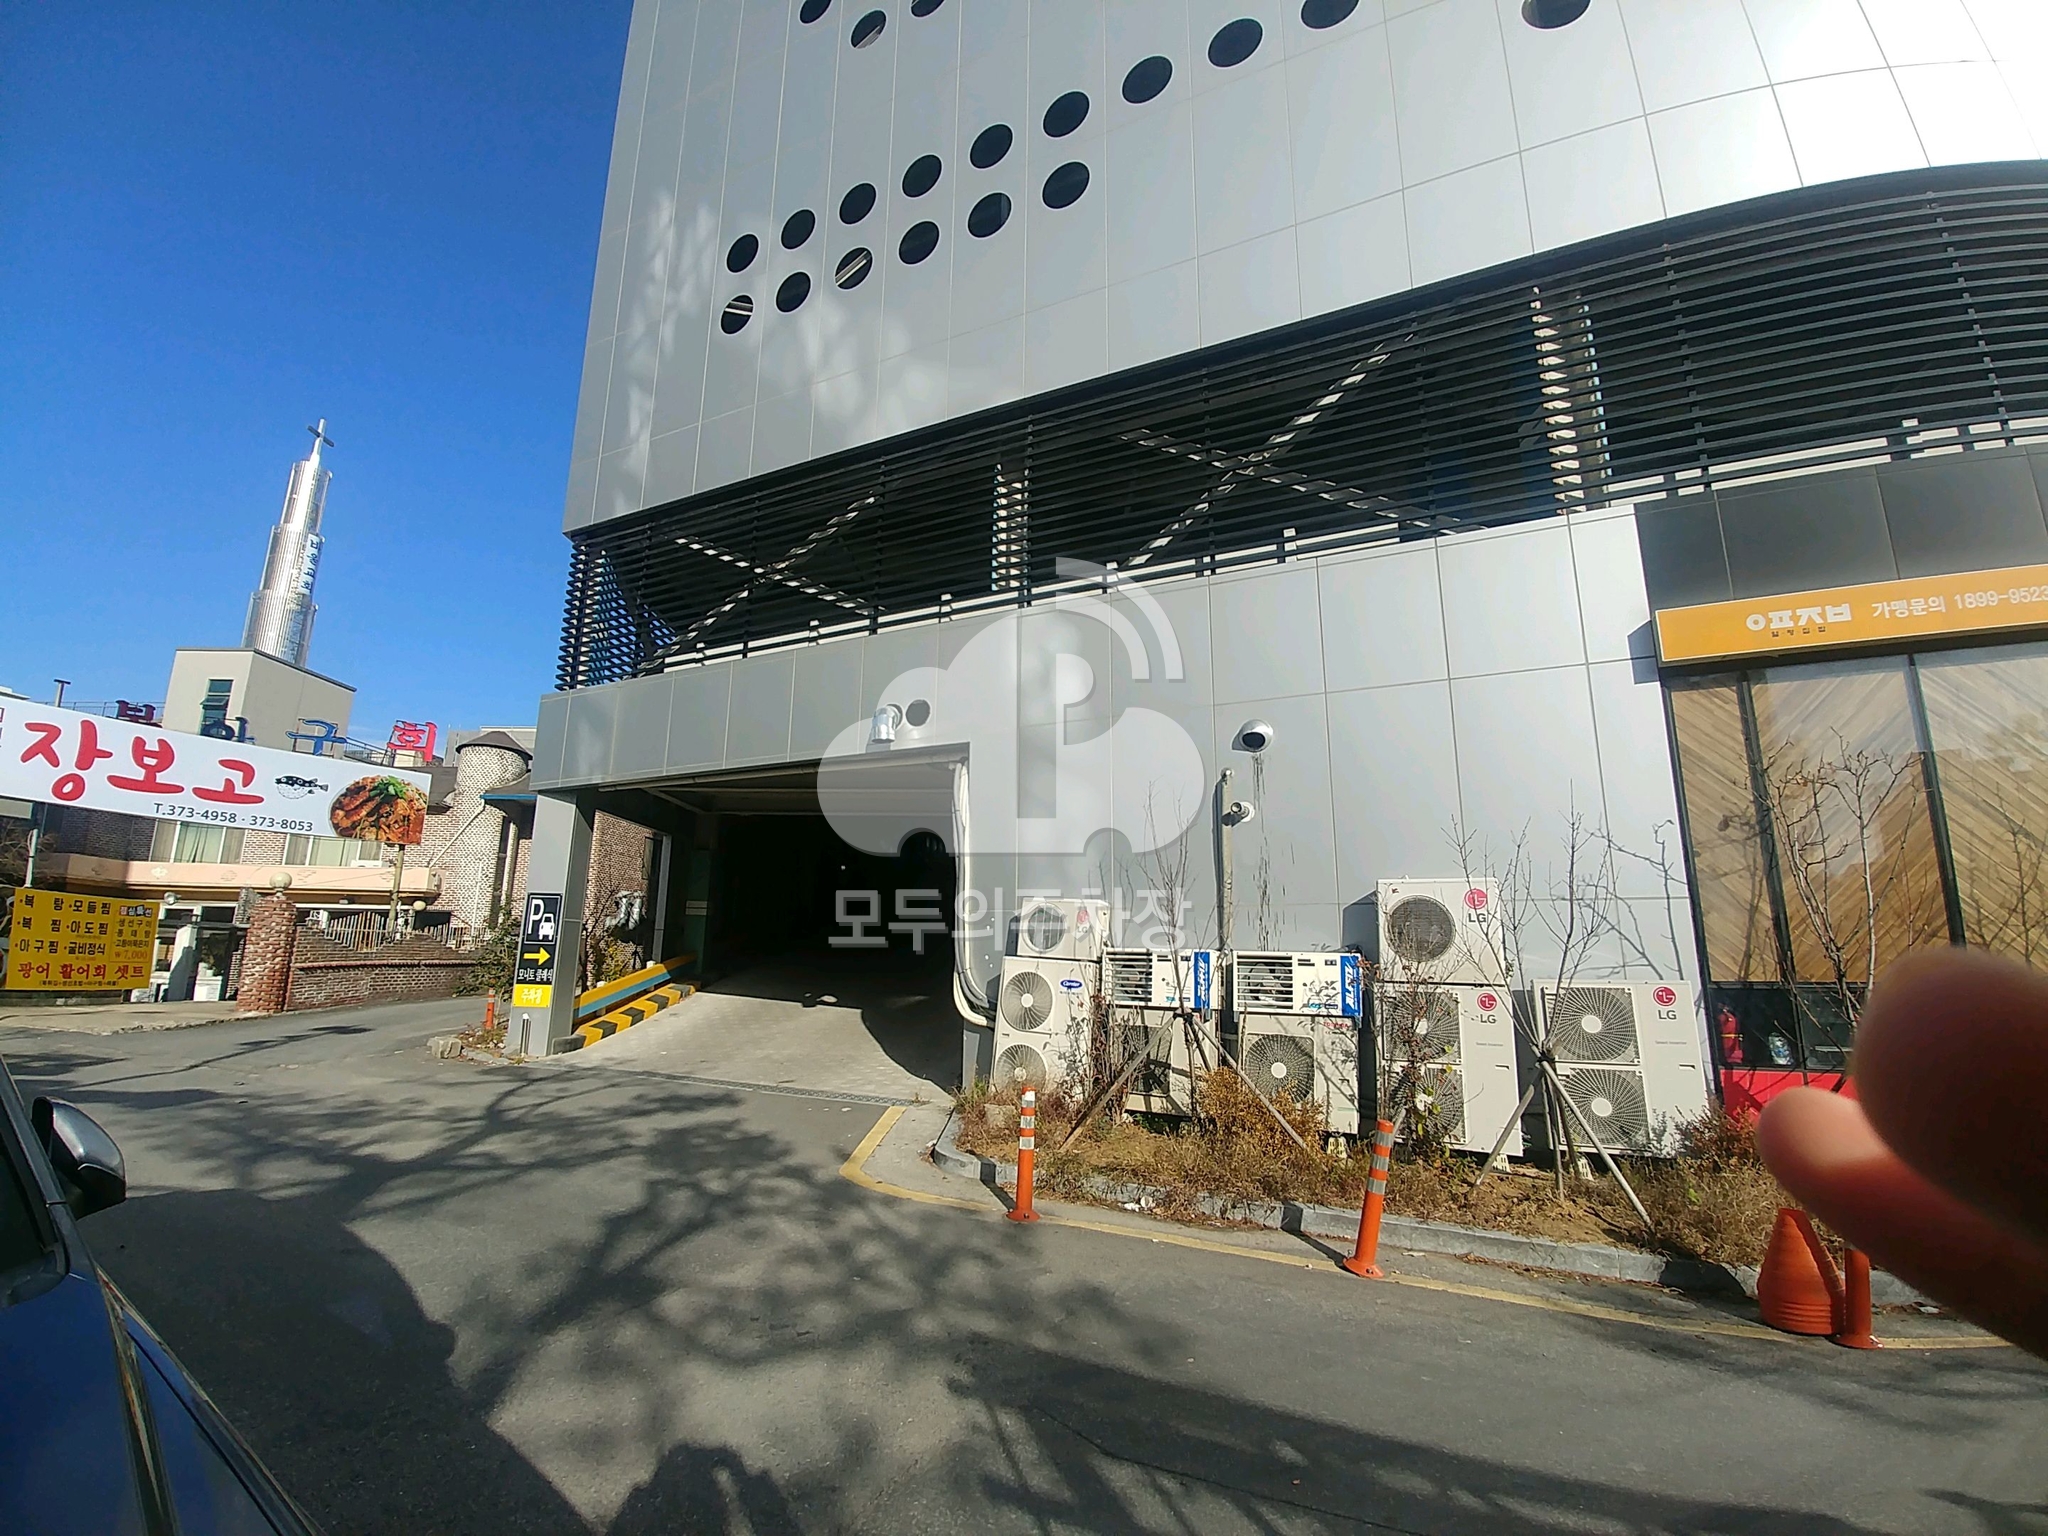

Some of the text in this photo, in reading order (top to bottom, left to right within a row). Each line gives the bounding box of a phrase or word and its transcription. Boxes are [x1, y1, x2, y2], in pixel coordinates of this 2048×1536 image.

[1871, 595, 1946, 620] 가맹문의
[1953, 585, 2048, 610] 1899-9523
[20, 719, 265, 805] 장보고
[249, 815, 314, 832] 373-8053
[527, 898, 545, 935] P
[1468, 912, 1487, 924] LG
[68, 941, 107, 956] 굴비정식
[18, 961, 51, 980] 광어
[114, 964, 145, 980] 셋트
[1479, 1013, 1497, 1024] LG
[1658, 1009, 1677, 1021] LG
